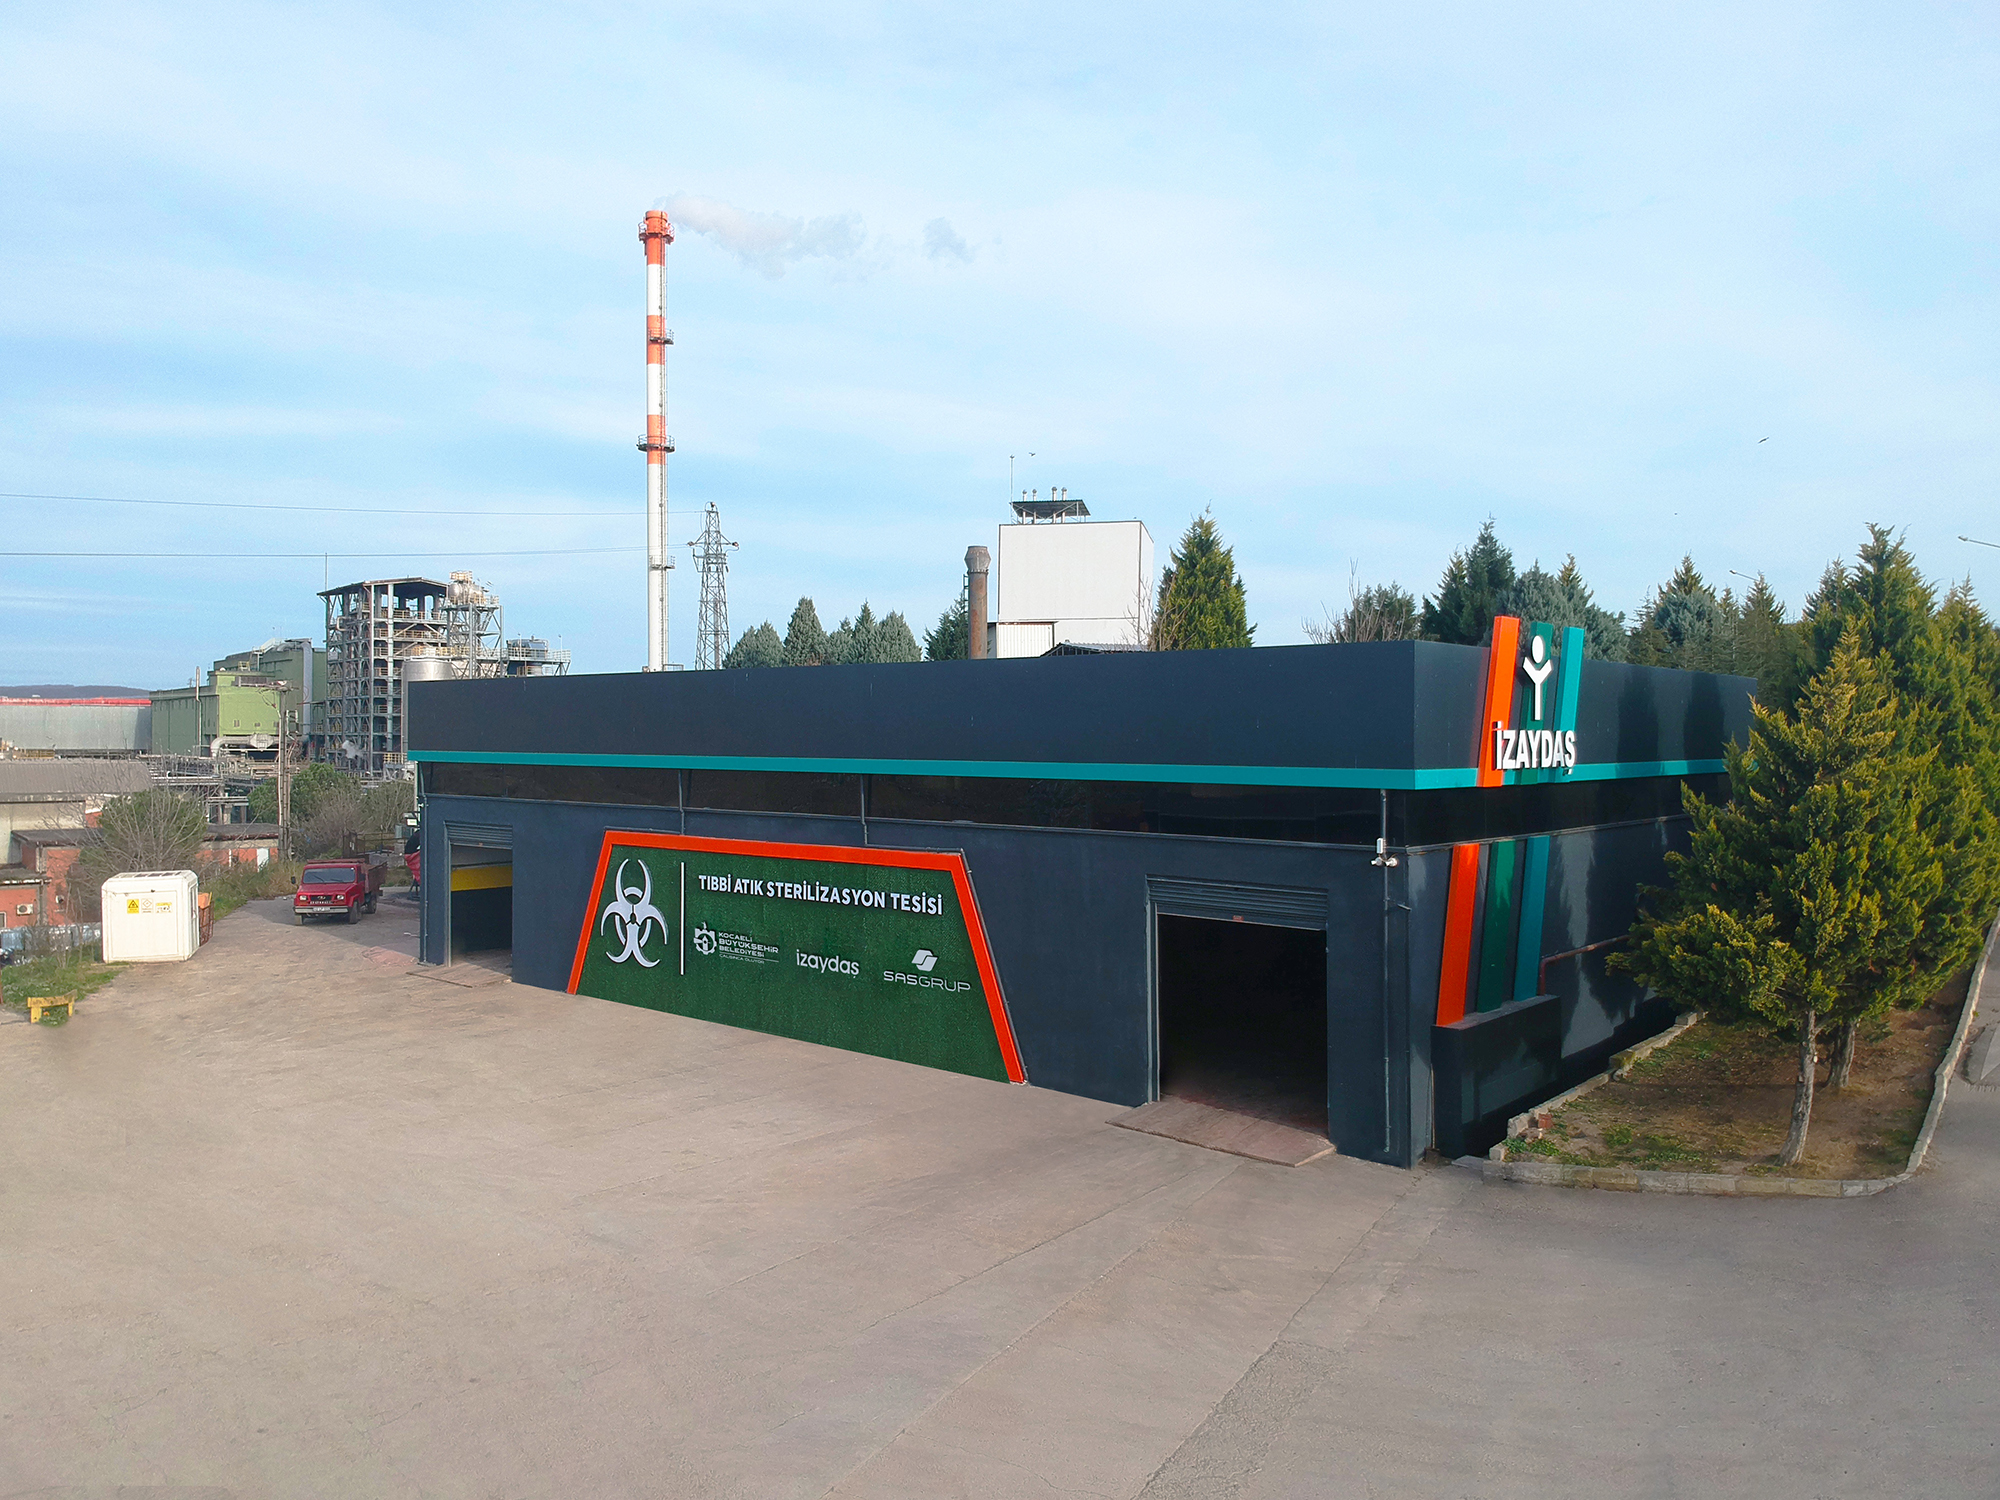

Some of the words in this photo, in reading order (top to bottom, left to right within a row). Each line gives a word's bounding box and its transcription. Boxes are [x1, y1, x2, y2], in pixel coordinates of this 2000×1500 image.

[698, 873, 732, 893] TIBBİ
[733, 878, 764, 896] ATIK
[766, 880, 886, 909] STERİLİZASYON
[890, 891, 943, 916] TESİSİ
[796, 949, 860, 979] izaydaş
[883, 970, 971, 993] SASGRUP
